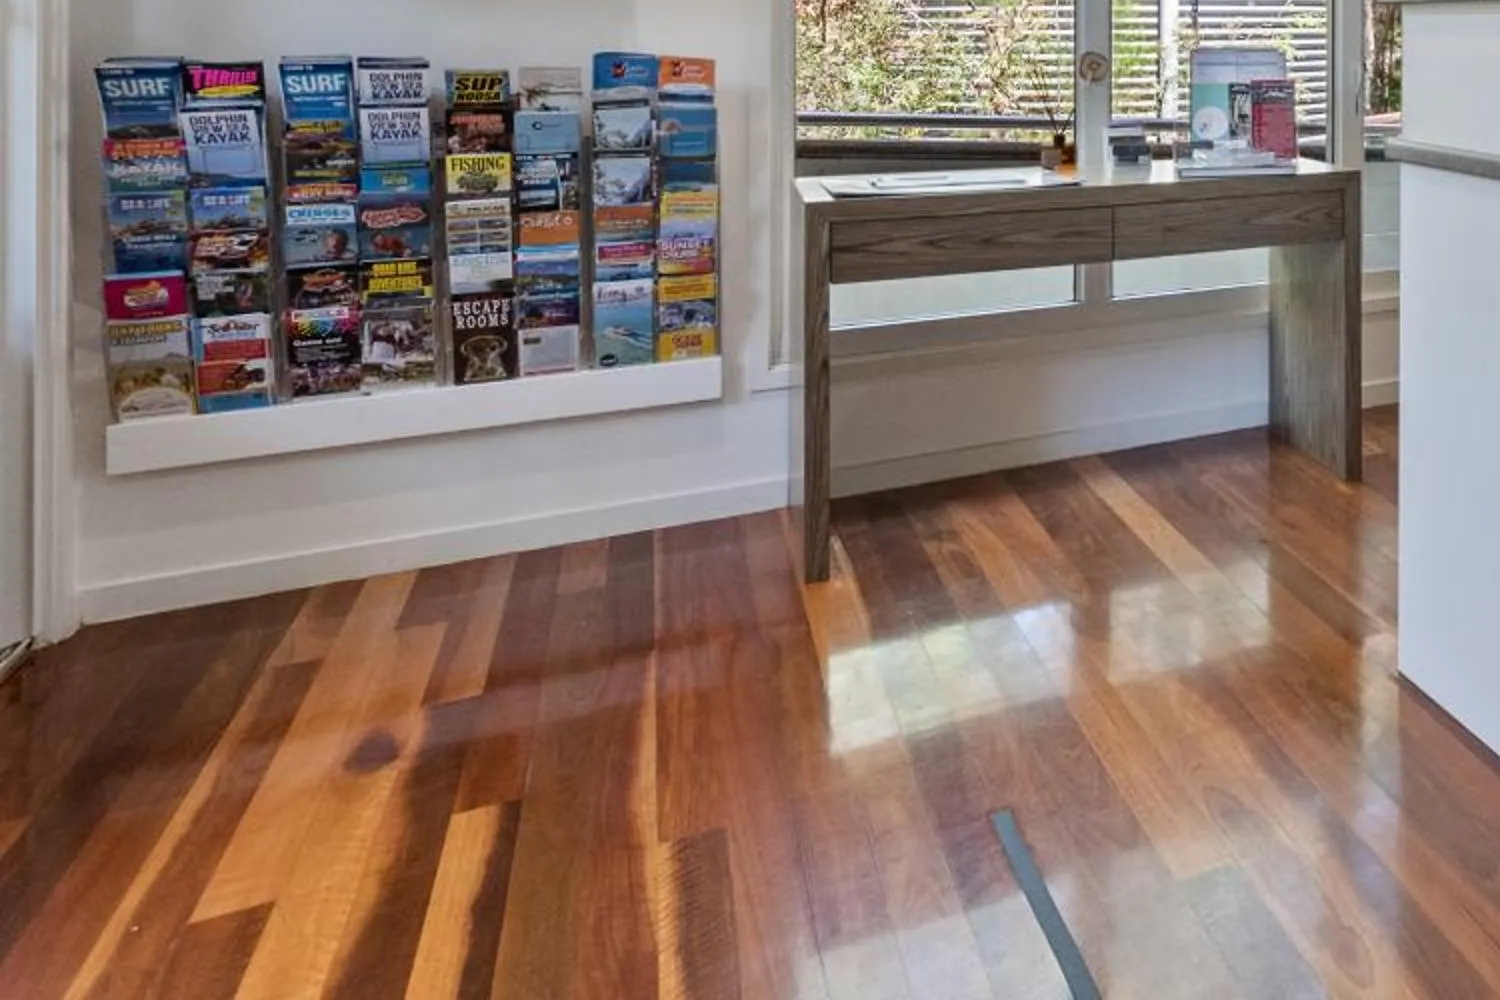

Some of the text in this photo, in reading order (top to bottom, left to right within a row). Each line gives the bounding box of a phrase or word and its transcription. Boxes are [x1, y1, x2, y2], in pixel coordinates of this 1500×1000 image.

[369, 72, 423, 82] DOLPHIN
[455, 76, 503, 91] SUP
[103, 77, 173, 99] SURF
[286, 74, 347, 94] SURF
[372, 90, 423, 100] KAYAK
[455, 91, 502, 102] NOOSA
[189, 113, 249, 126] DOLPHIN
[367, 111, 421, 121] DOLPHIN
[193, 132, 251, 145] KAYAK
[370, 129, 422, 140] KAYAK
[451, 156, 505, 172] FISHING
[453, 297, 511, 317] ESCAPE
[456, 314, 509, 329] ROOMS
